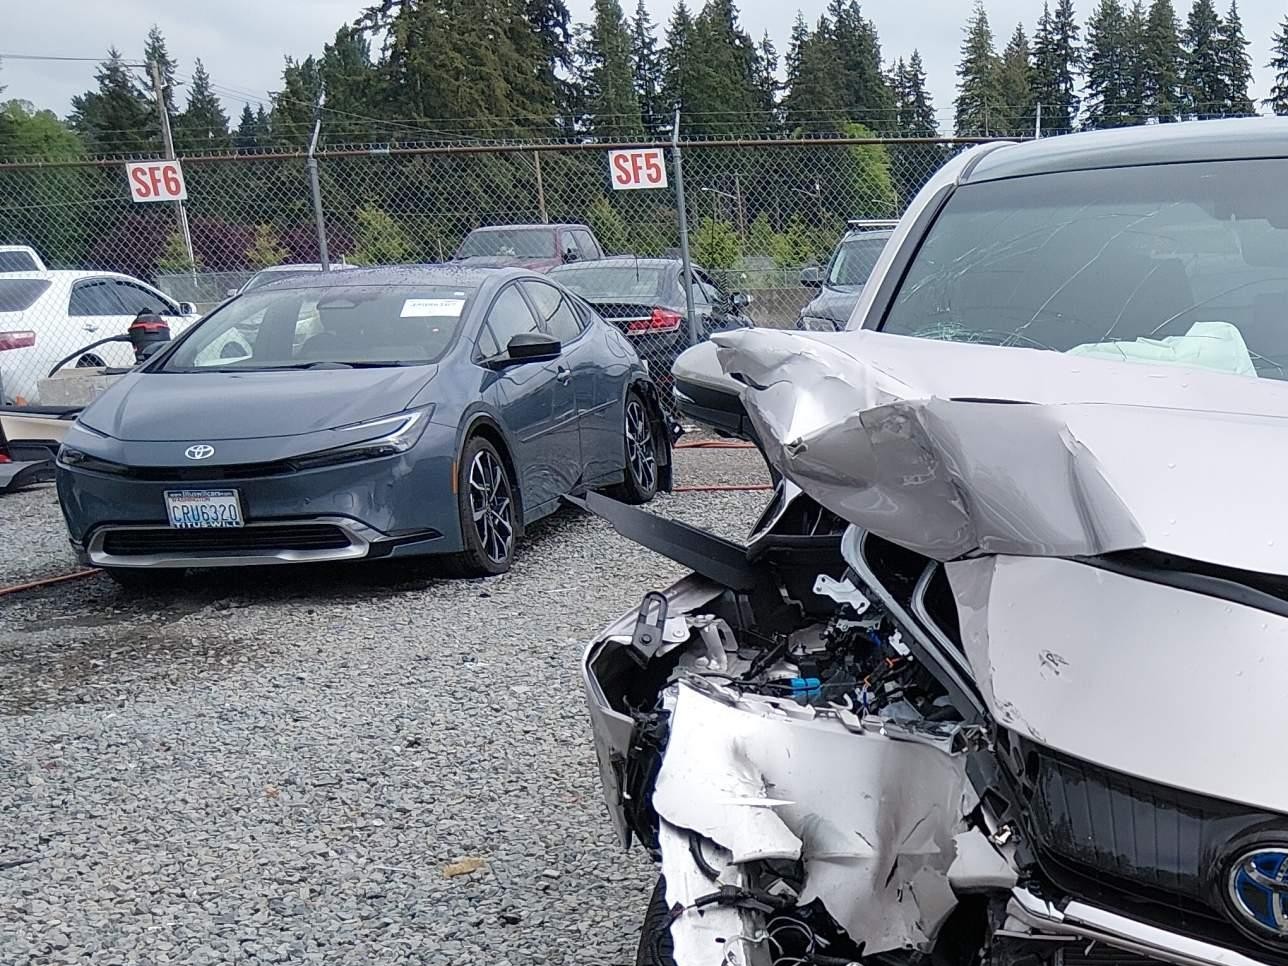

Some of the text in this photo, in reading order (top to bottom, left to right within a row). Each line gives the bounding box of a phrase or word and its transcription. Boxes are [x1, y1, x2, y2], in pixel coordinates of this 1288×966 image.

[132, 165, 180, 197] SF6
[613, 153, 662, 185] SF5
[172, 504, 238, 523] CRU6320
